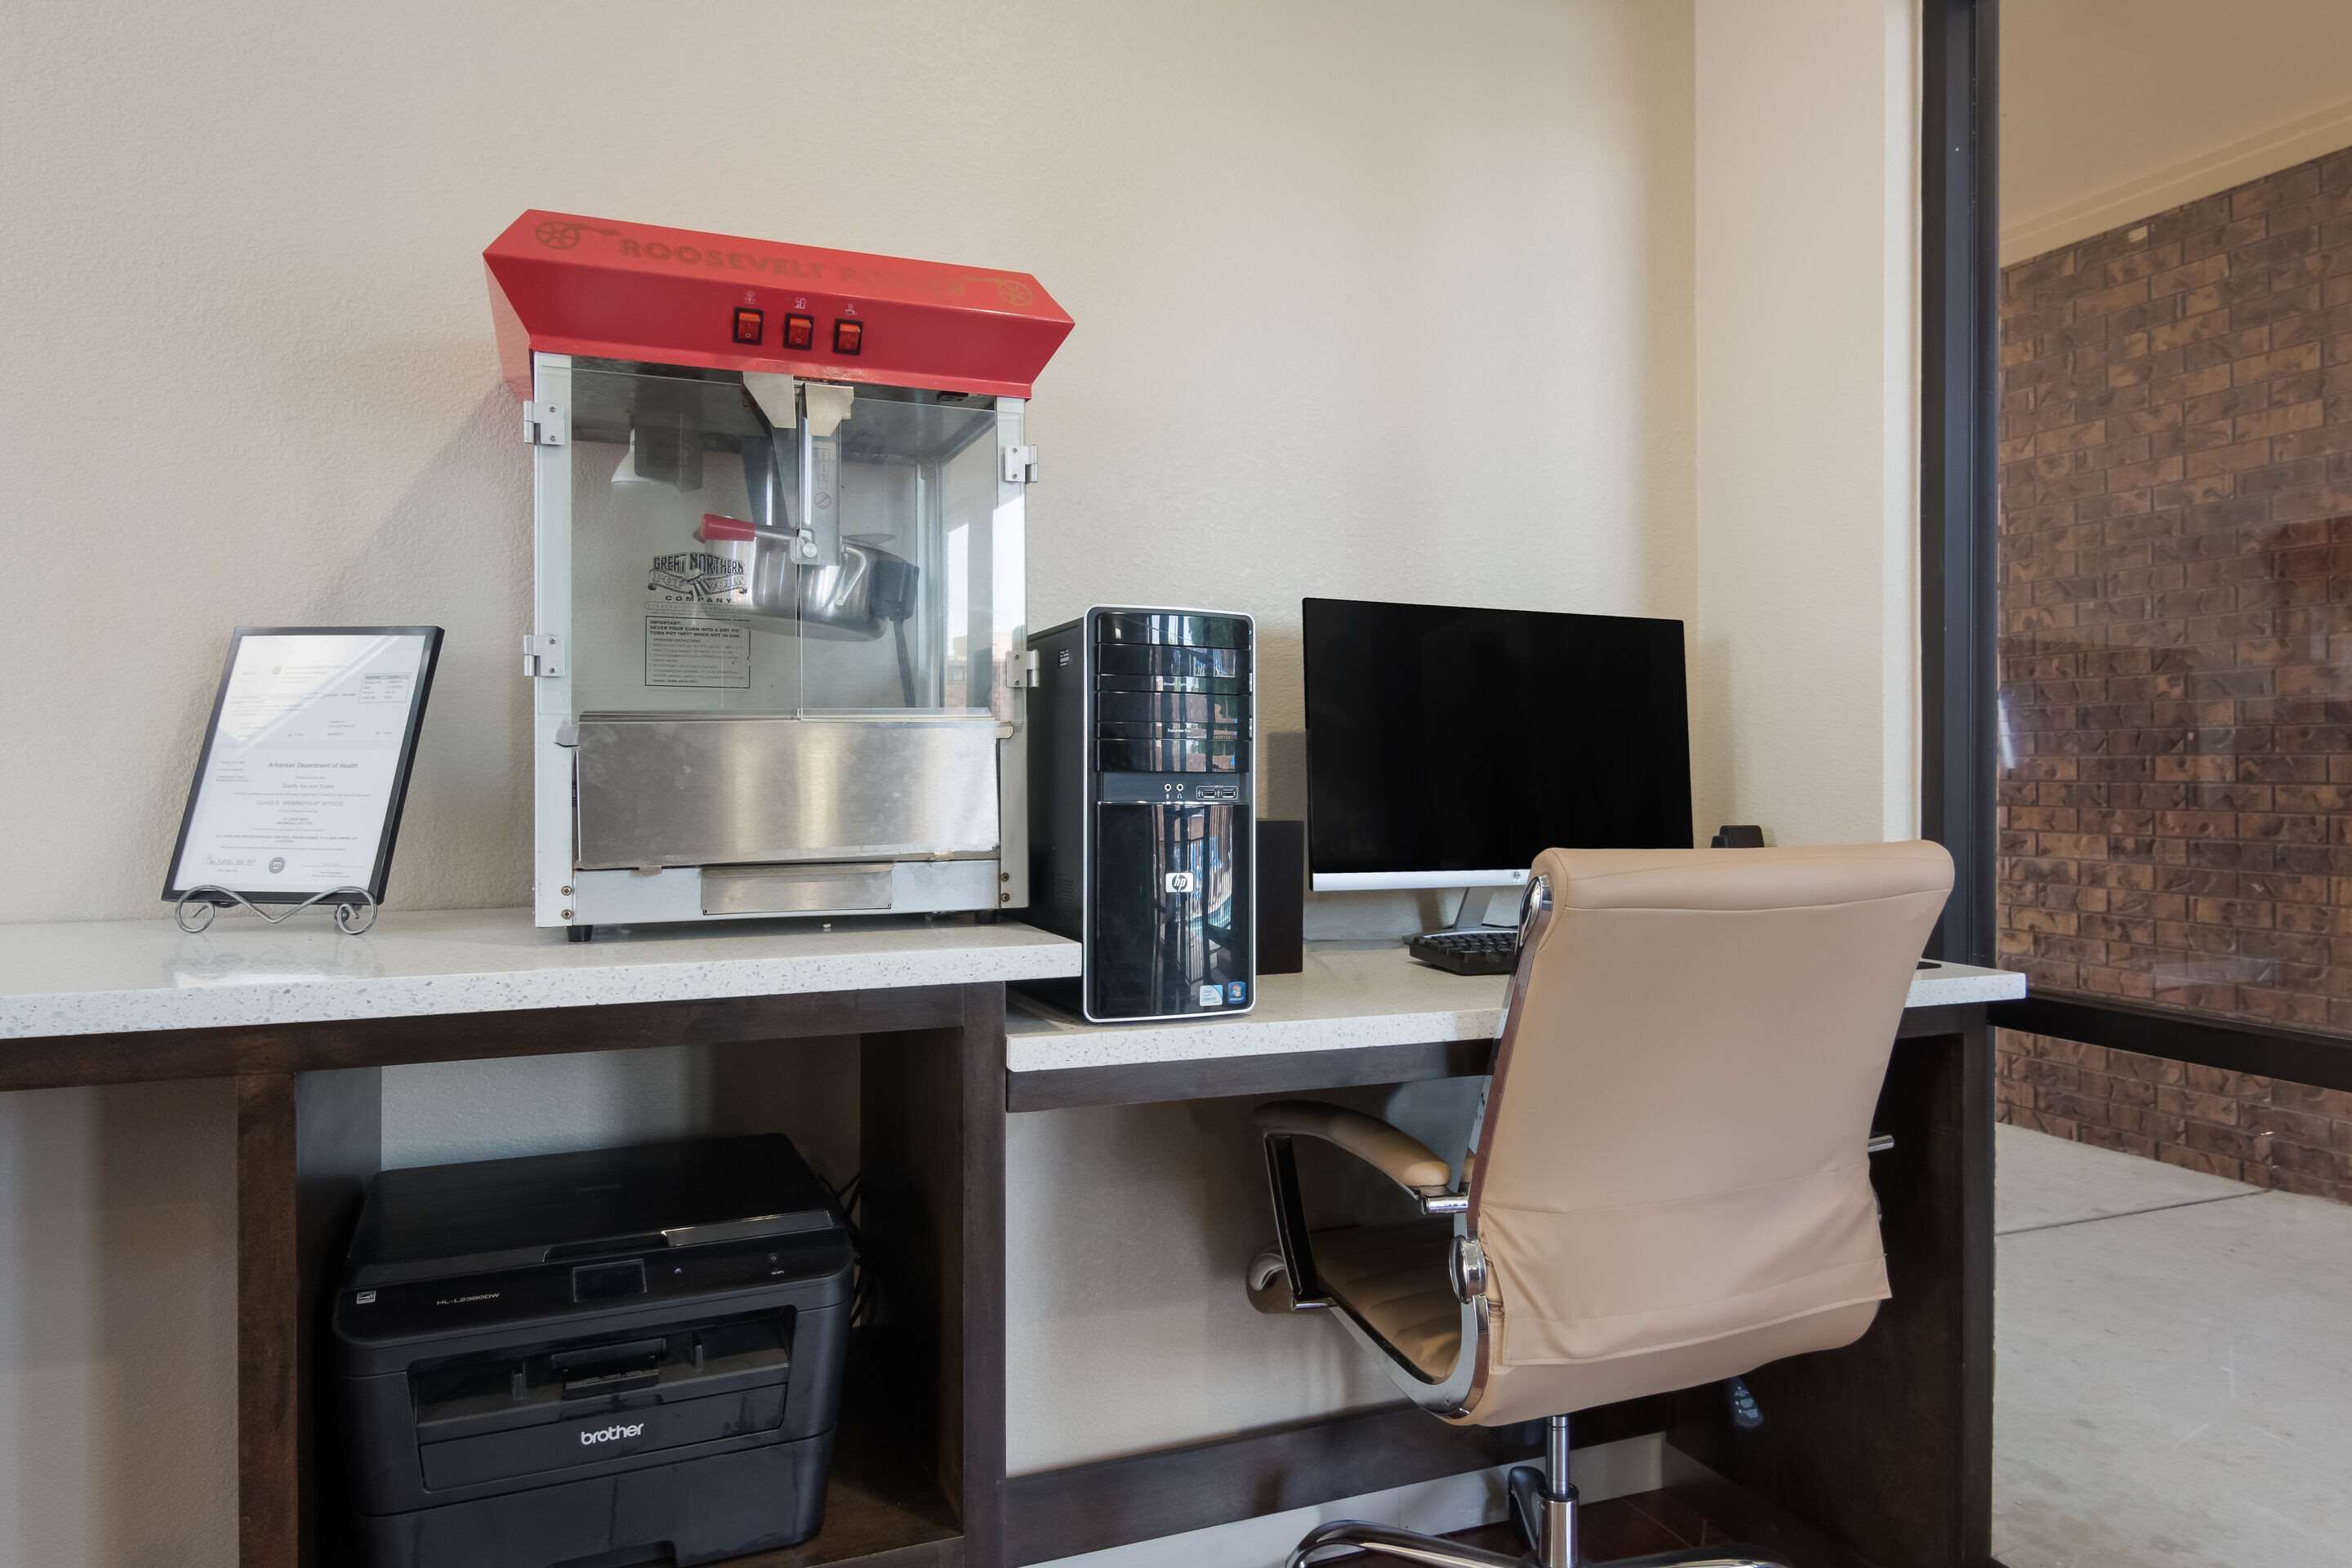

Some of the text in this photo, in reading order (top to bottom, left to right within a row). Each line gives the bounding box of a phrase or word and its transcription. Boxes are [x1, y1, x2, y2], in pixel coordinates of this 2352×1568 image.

[619, 238, 825, 278] ROOSEVELT
[653, 553, 745, 575] GREAT NORTHERN
[665, 595, 732, 604] COMPANY
[581, 1423, 644, 1446] brother
